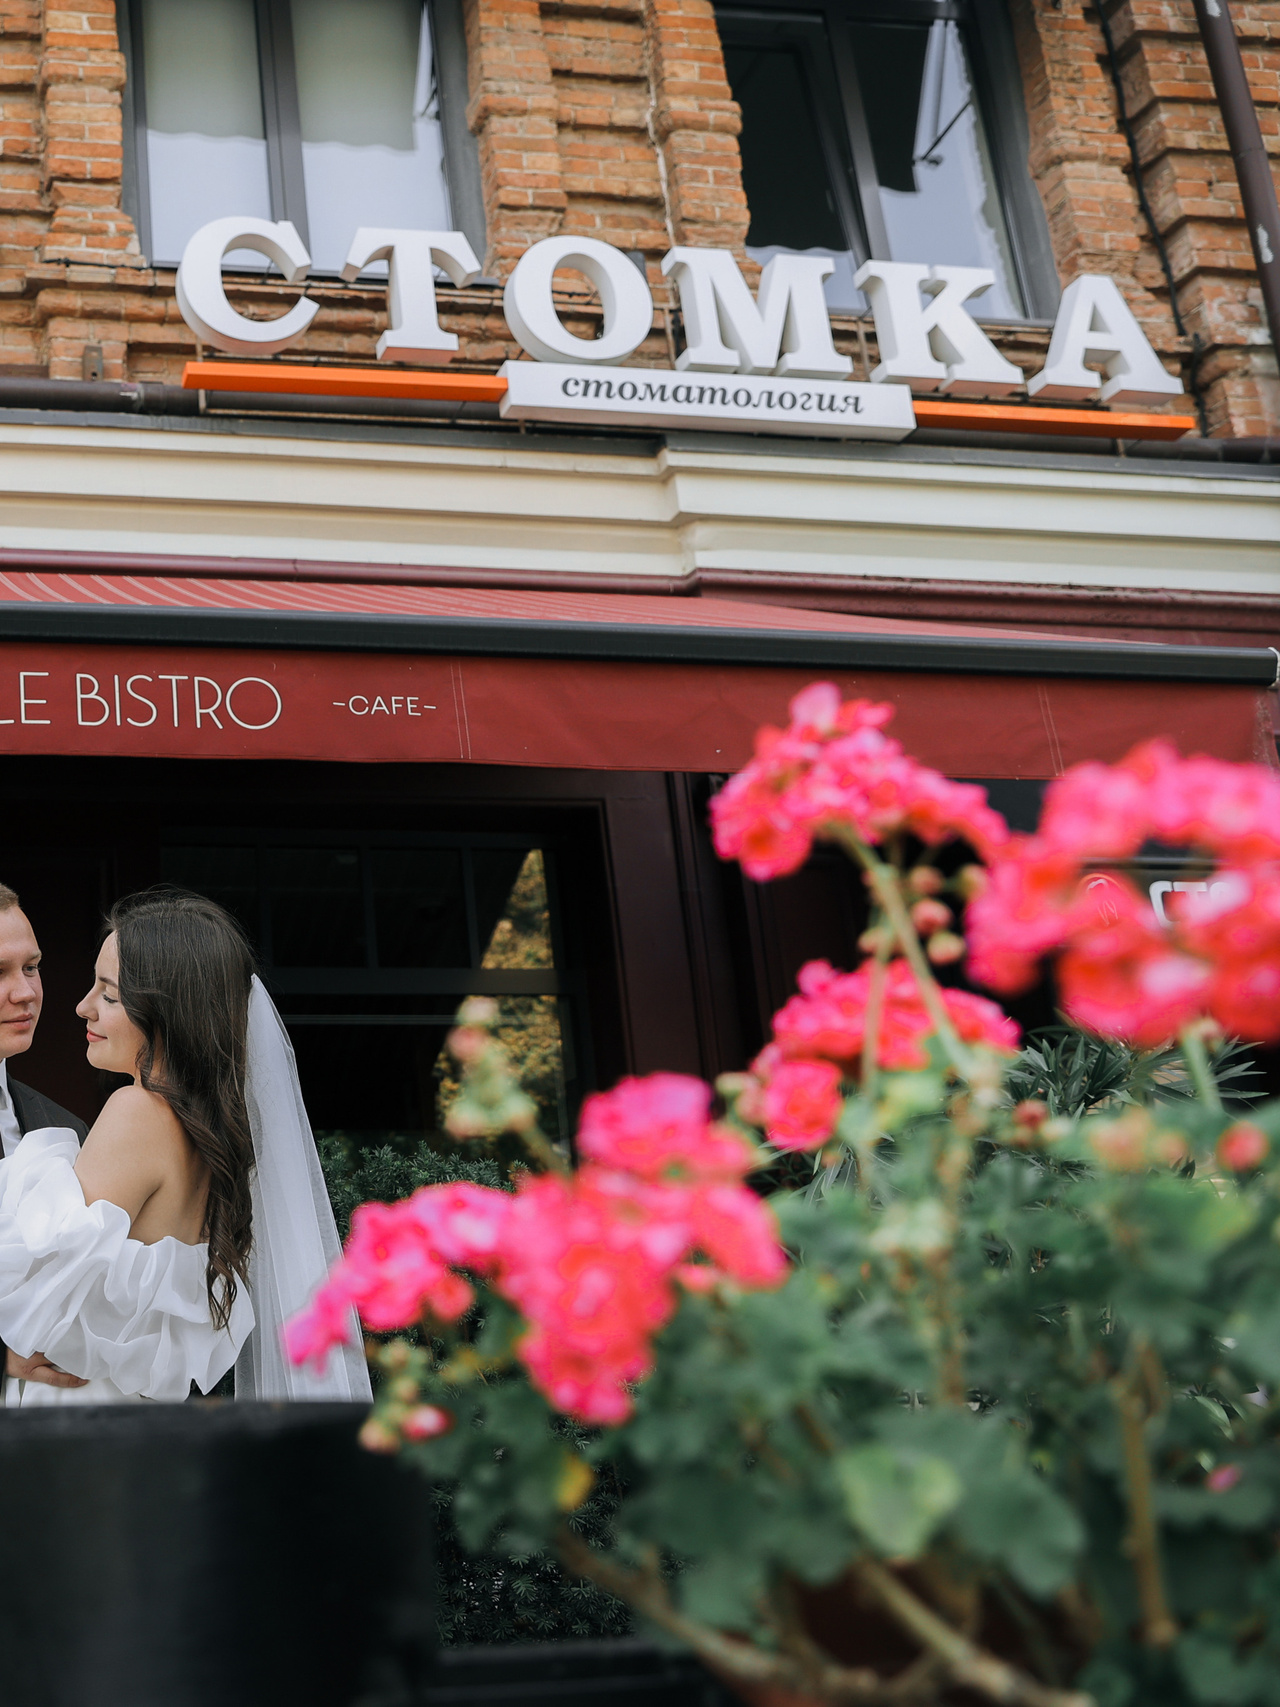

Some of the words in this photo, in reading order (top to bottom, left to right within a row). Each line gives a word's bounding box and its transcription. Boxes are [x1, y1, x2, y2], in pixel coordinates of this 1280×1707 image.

[176, 216, 1185, 405] СТОМКА
[560, 377, 864, 415] стоматология
[76, 673, 282, 730] BISTRO
